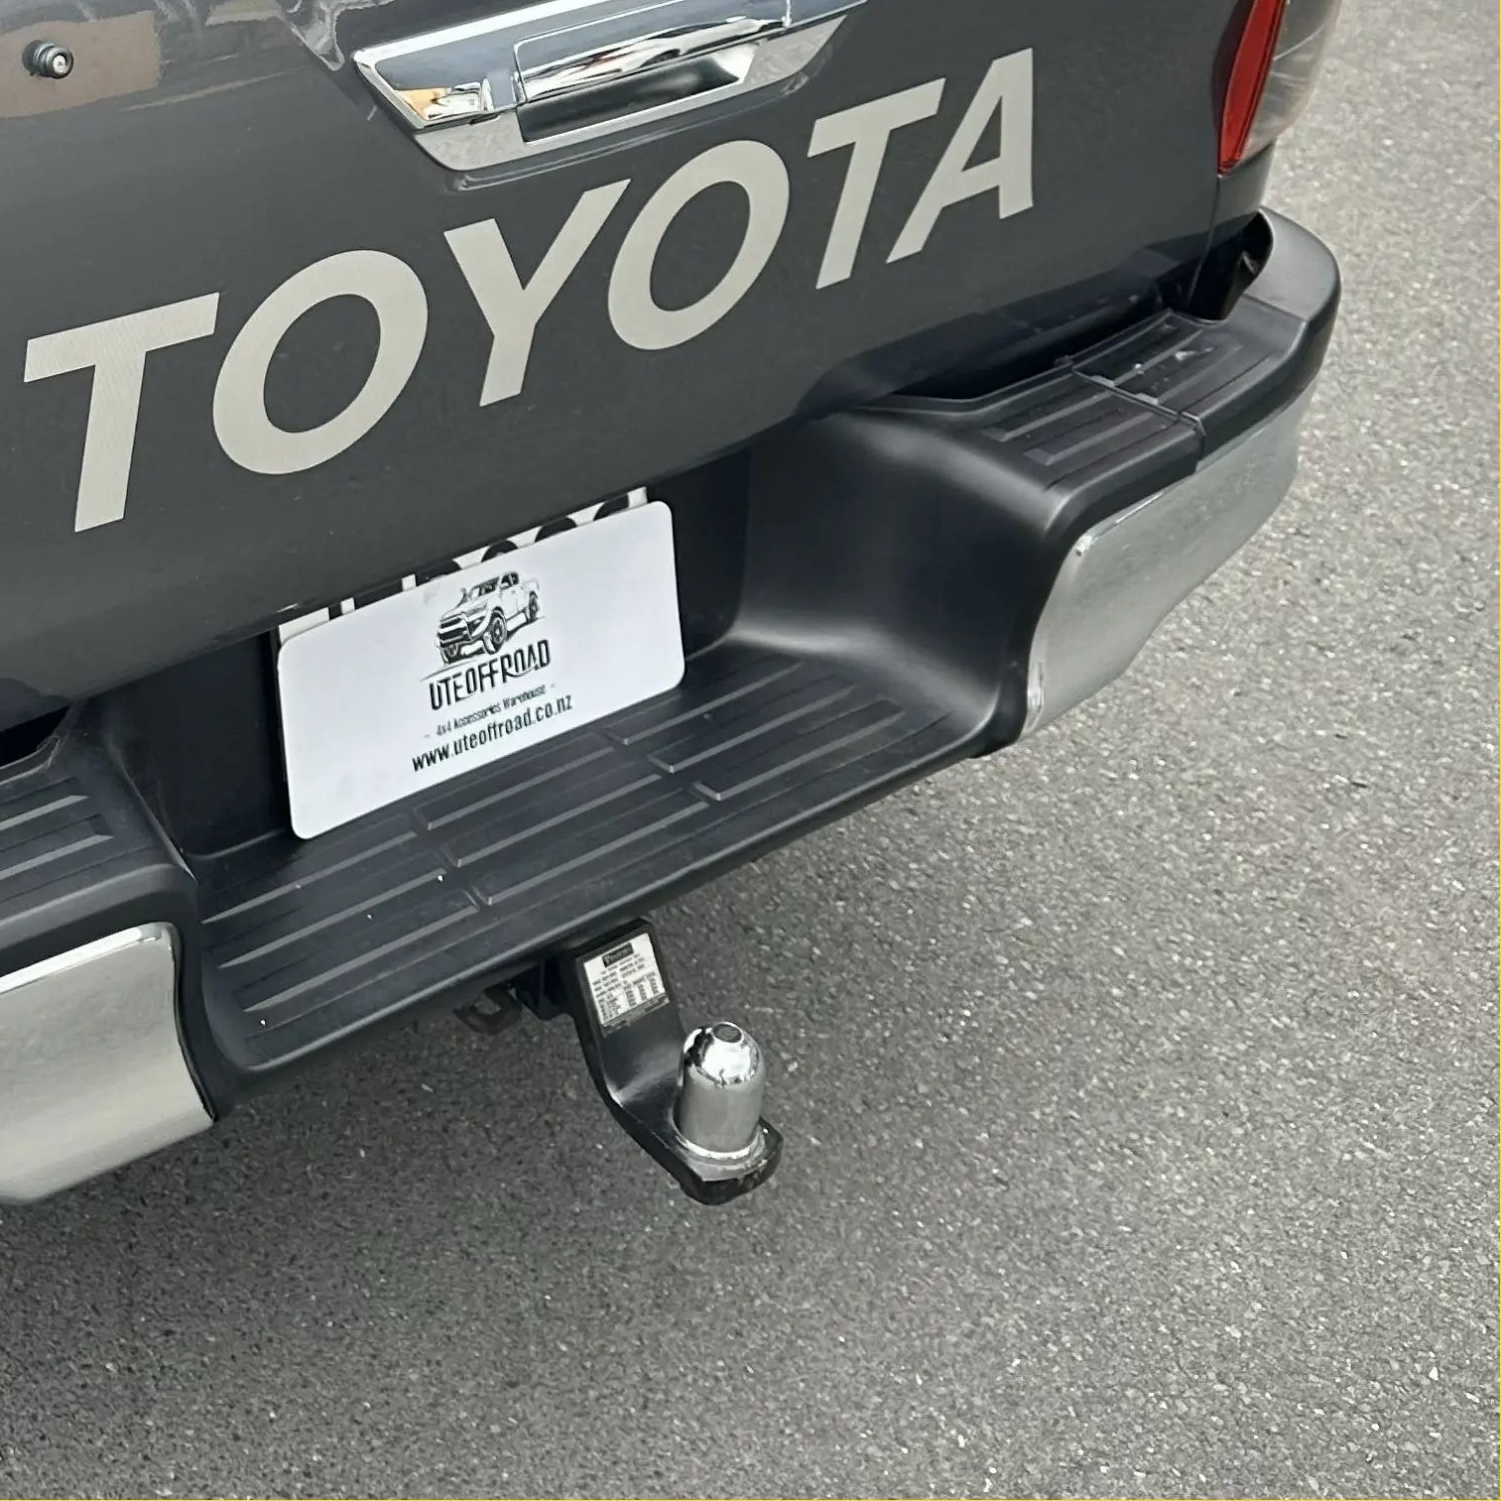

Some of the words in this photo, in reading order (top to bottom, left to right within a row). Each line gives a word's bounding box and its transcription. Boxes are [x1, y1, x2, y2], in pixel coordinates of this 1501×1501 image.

[24, 47, 1035, 533] TOYOTA
[428, 638, 552, 711] UTEOFFROAD
[411, 694, 574, 773] www.uteoffroad.co.nz
